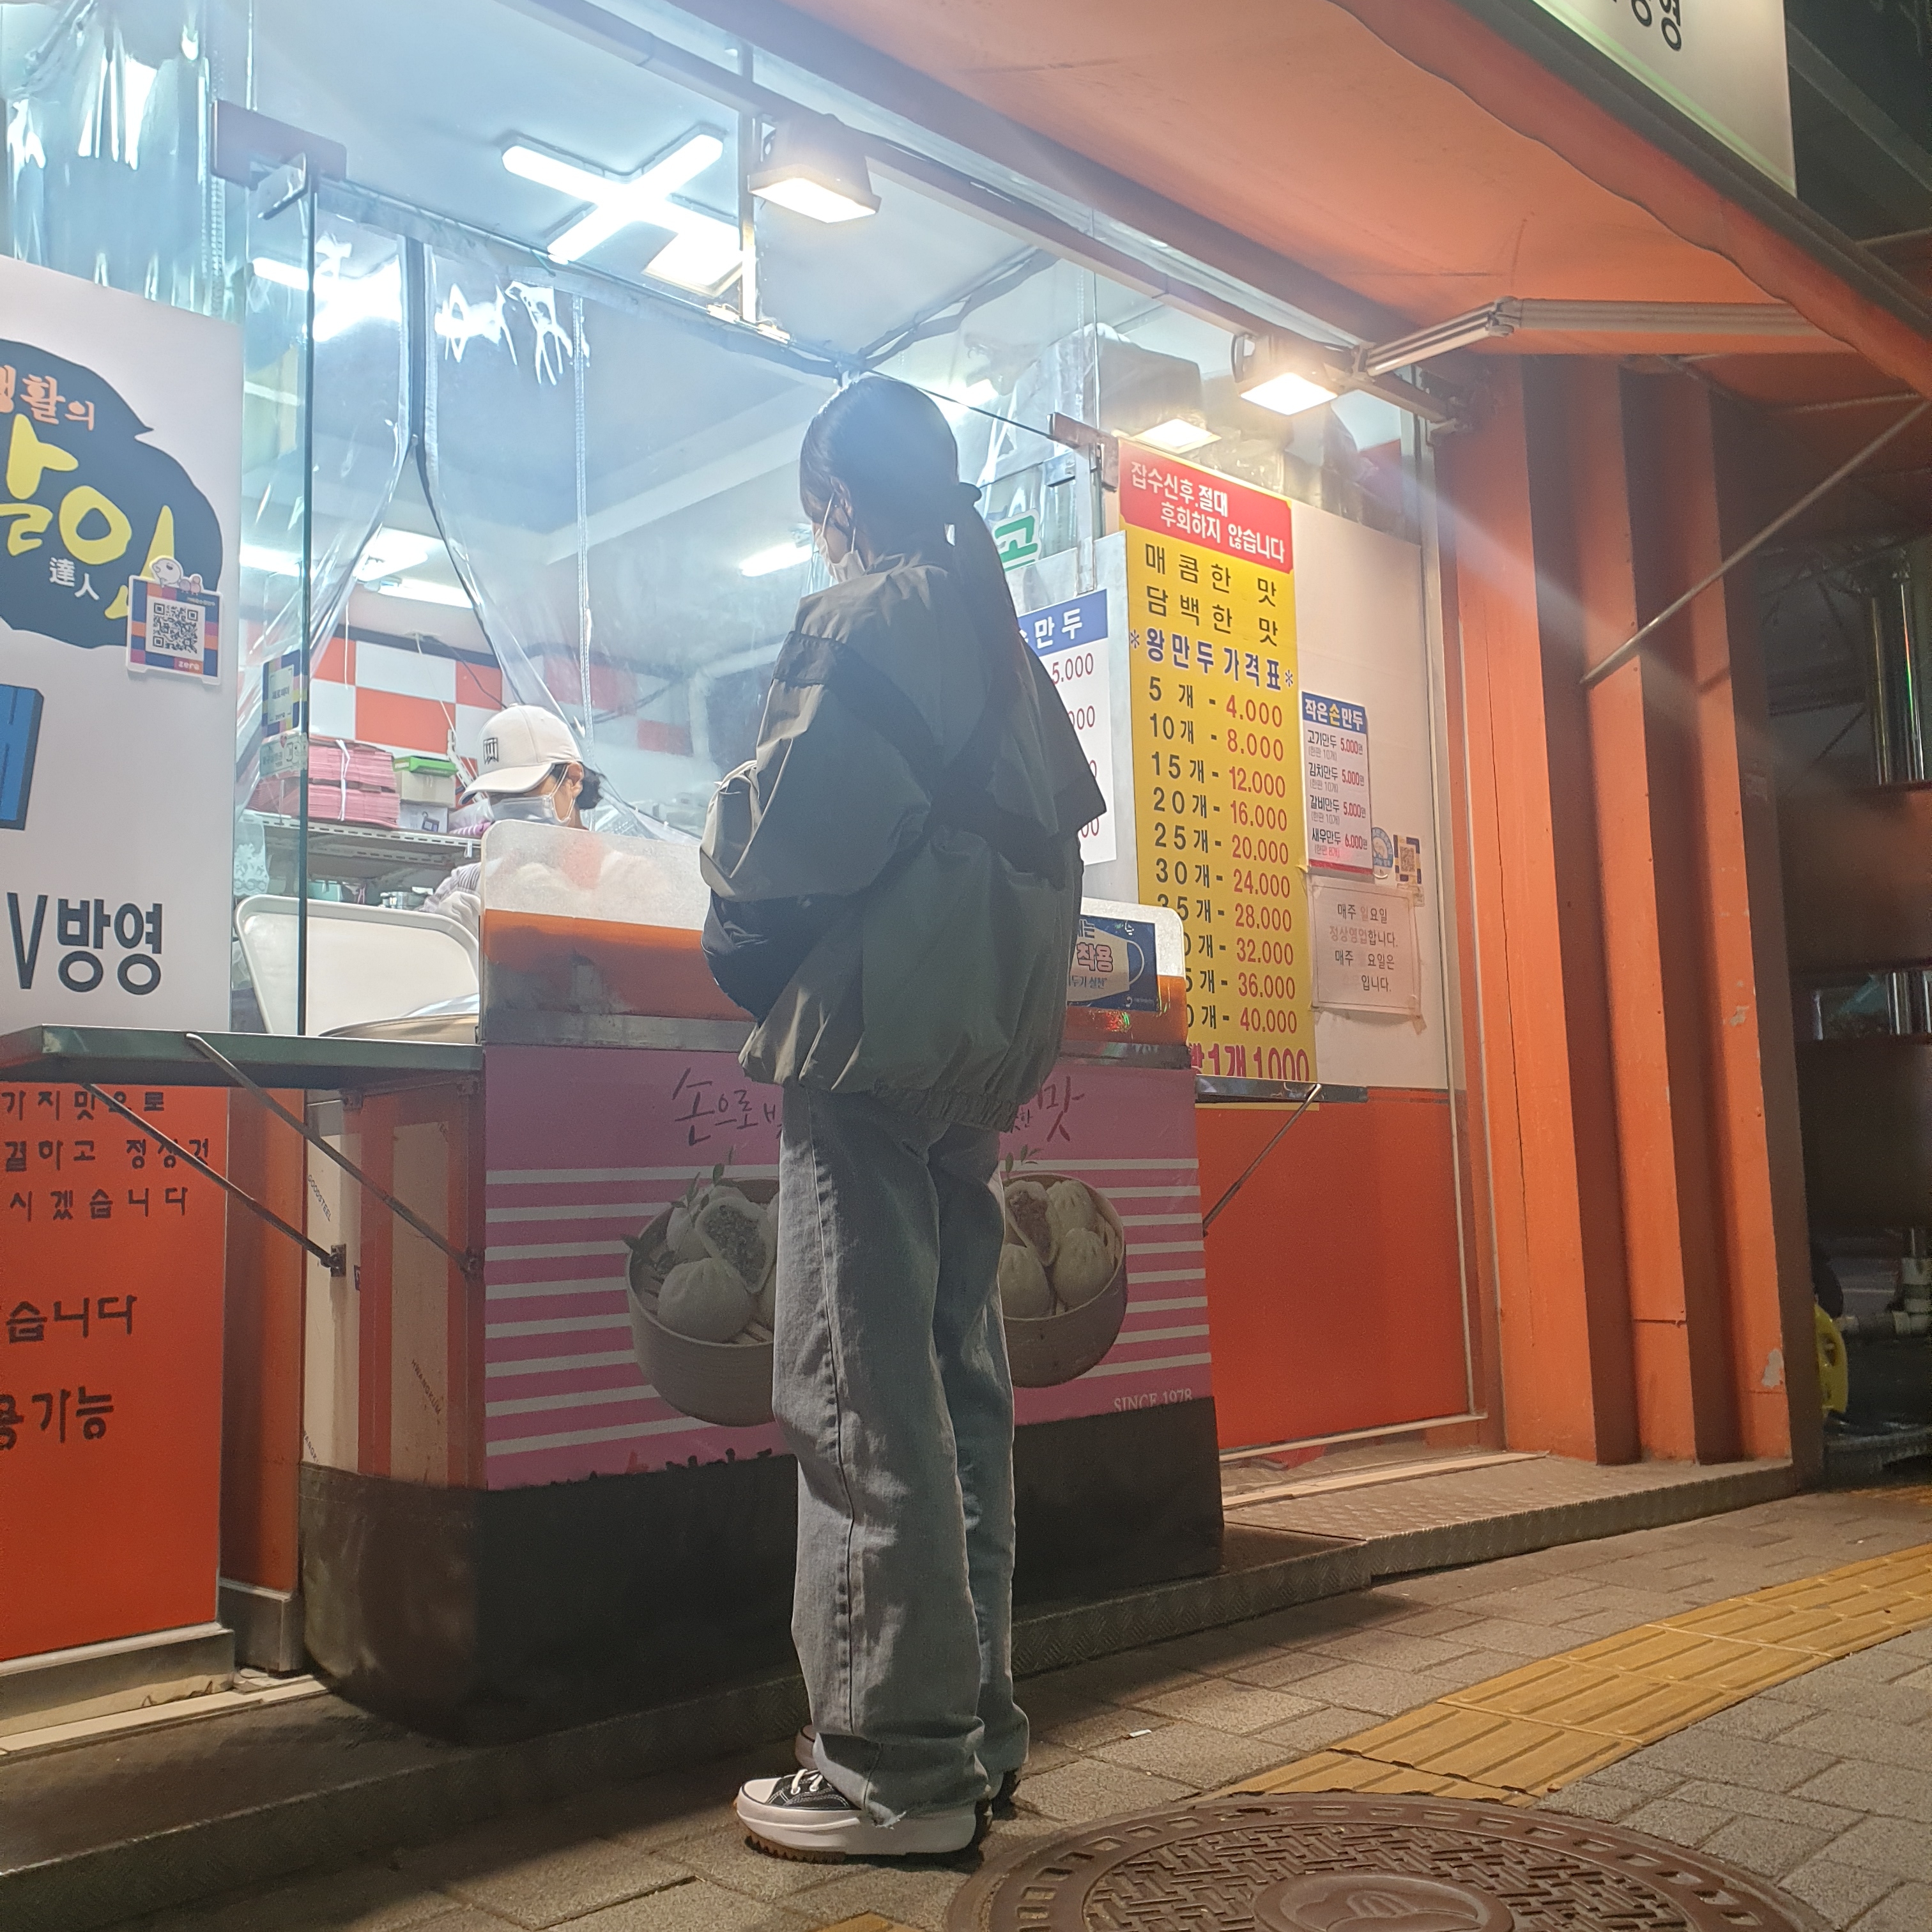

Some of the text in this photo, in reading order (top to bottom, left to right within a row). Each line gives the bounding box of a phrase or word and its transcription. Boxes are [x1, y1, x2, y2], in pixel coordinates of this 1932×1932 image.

[1161, 502, 1285, 563] 후회하지 않습니다
[49, 557, 100, 601] 達人
[1257, 578, 1276, 607] 맛
[1259, 617, 1278, 647] 맛
[1052, 653, 1094, 685] 5.000
[1226, 694, 1282, 728] 4.000
[1227, 730, 1284, 762] 8.000
[1308, 730, 1337, 748] 고기만두
[1229, 767, 1285, 798] 12.000
[1308, 762, 1338, 780] 김치만두
[1230, 801, 1287, 831] 16.000
[1310, 795, 1340, 813] 갈비만두
[1232, 834, 1289, 864] 20.000
[1312, 827, 1341, 845] 새우만두
[1233, 868, 1290, 898] 24.000
[1235, 903, 1292, 932] 28.000
[1337, 903, 1356, 920] 매주
[1077, 942, 1113, 972] 착용
[1236, 937, 1293, 966] 32.000
[1335, 950, 1395, 970] 매주 요일은
[1238, 972, 1296, 1000] 36.000
[1361, 974, 1392, 992] 입니다.
[1240, 1007, 1297, 1034] 40.000
[671, 1067, 758, 1146] 손으로
[1038, 1076, 1085, 1142] 맛
[1114, 1393, 1157, 1412] SINCE
